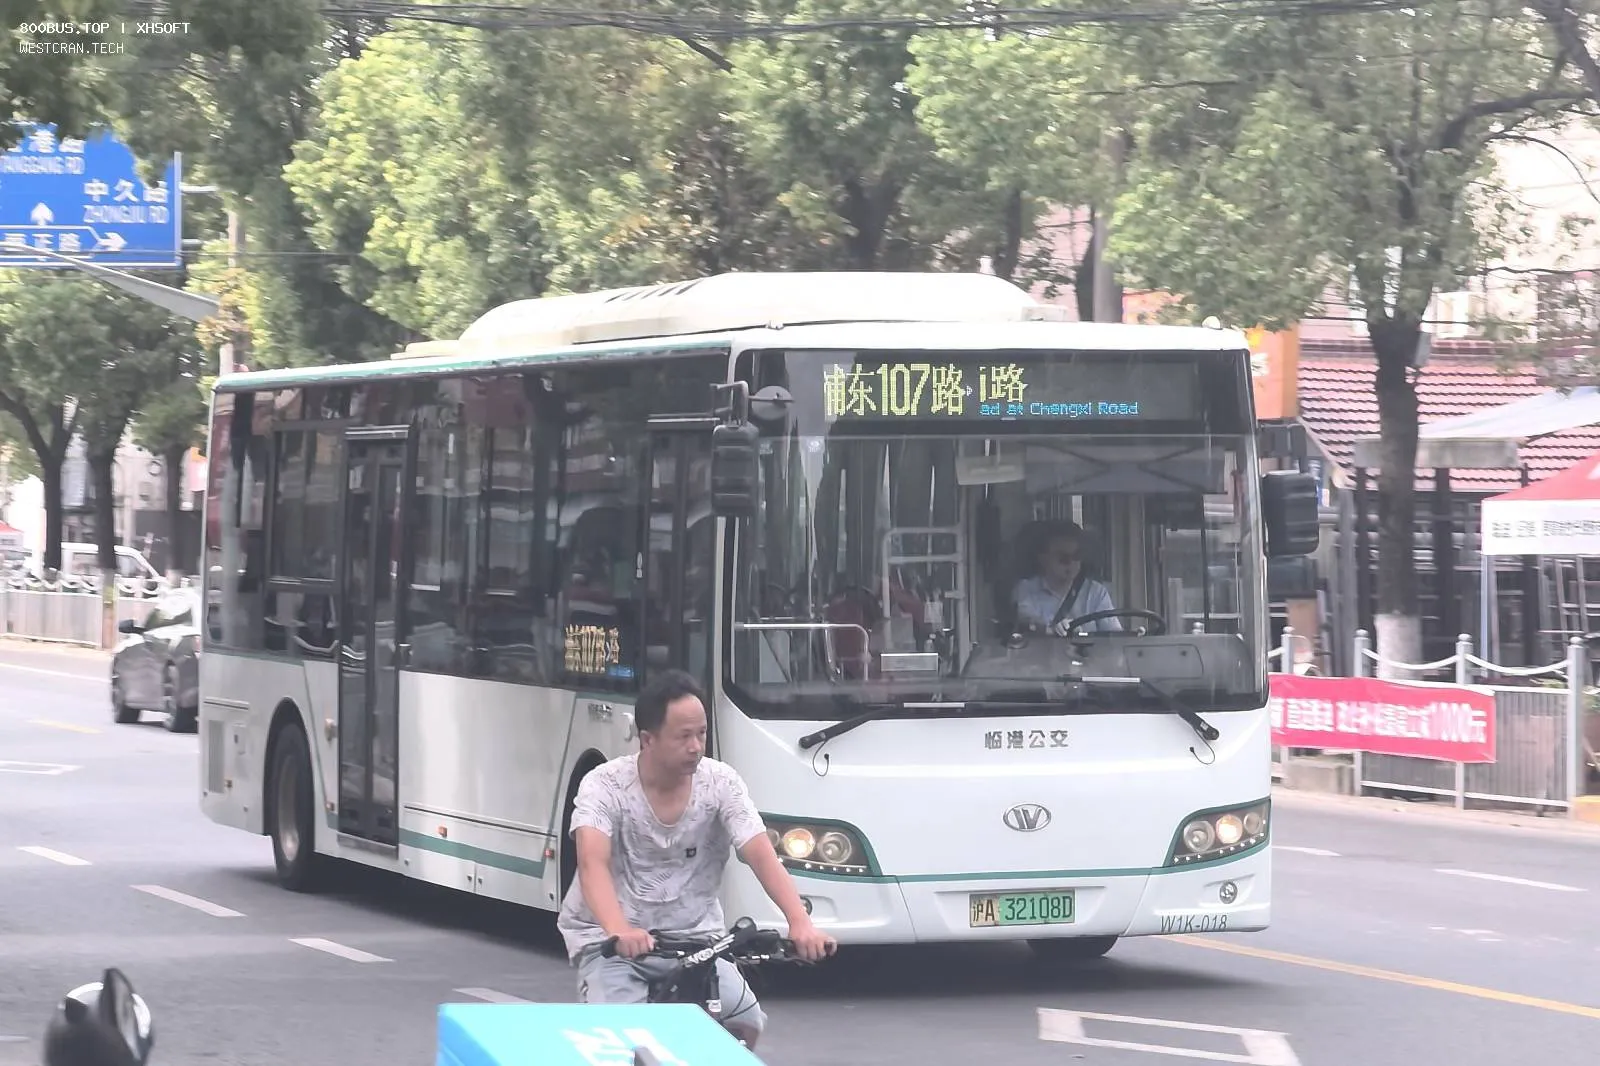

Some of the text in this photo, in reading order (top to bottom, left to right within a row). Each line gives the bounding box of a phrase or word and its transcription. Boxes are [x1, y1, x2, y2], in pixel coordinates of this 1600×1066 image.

[1097, 401, 1139, 415] Road
[984, 729, 1069, 750] 临港公交
[972, 895, 1073, 922] 沪A 32108D
[1160, 914, 1228, 934] W1K-018
